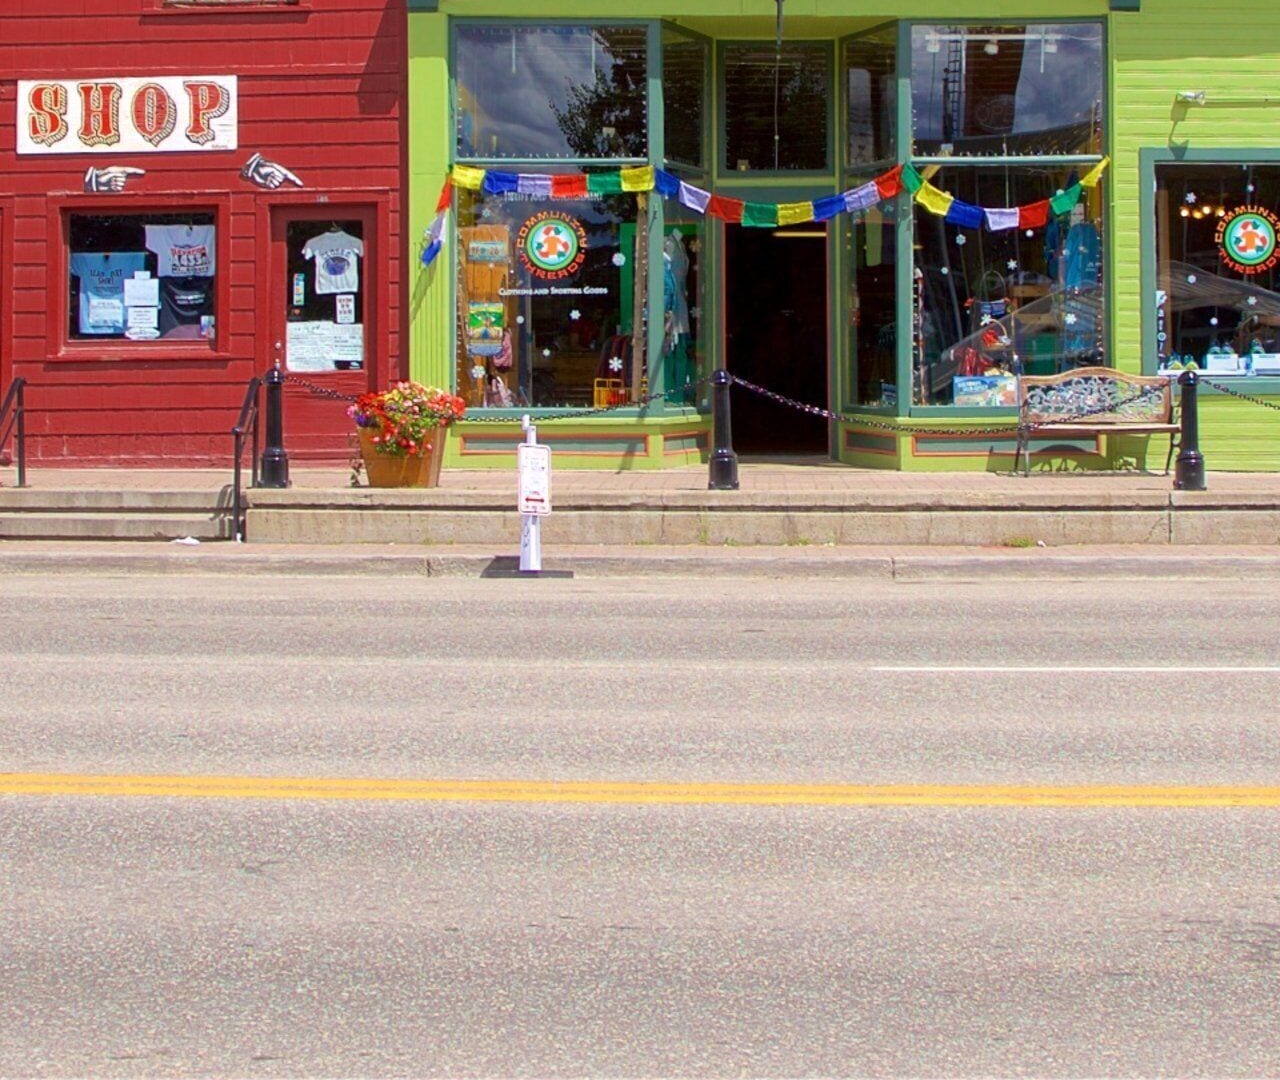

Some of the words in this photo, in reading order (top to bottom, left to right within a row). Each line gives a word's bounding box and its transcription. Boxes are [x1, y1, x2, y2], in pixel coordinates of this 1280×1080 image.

[28, 80, 230, 148] SHOP
[516, 211, 588, 248] COMMUNITY
[520, 253, 586, 280] THREADS
[550, 286, 582, 295] SPORTING
[583, 286, 608, 295] GOODS
